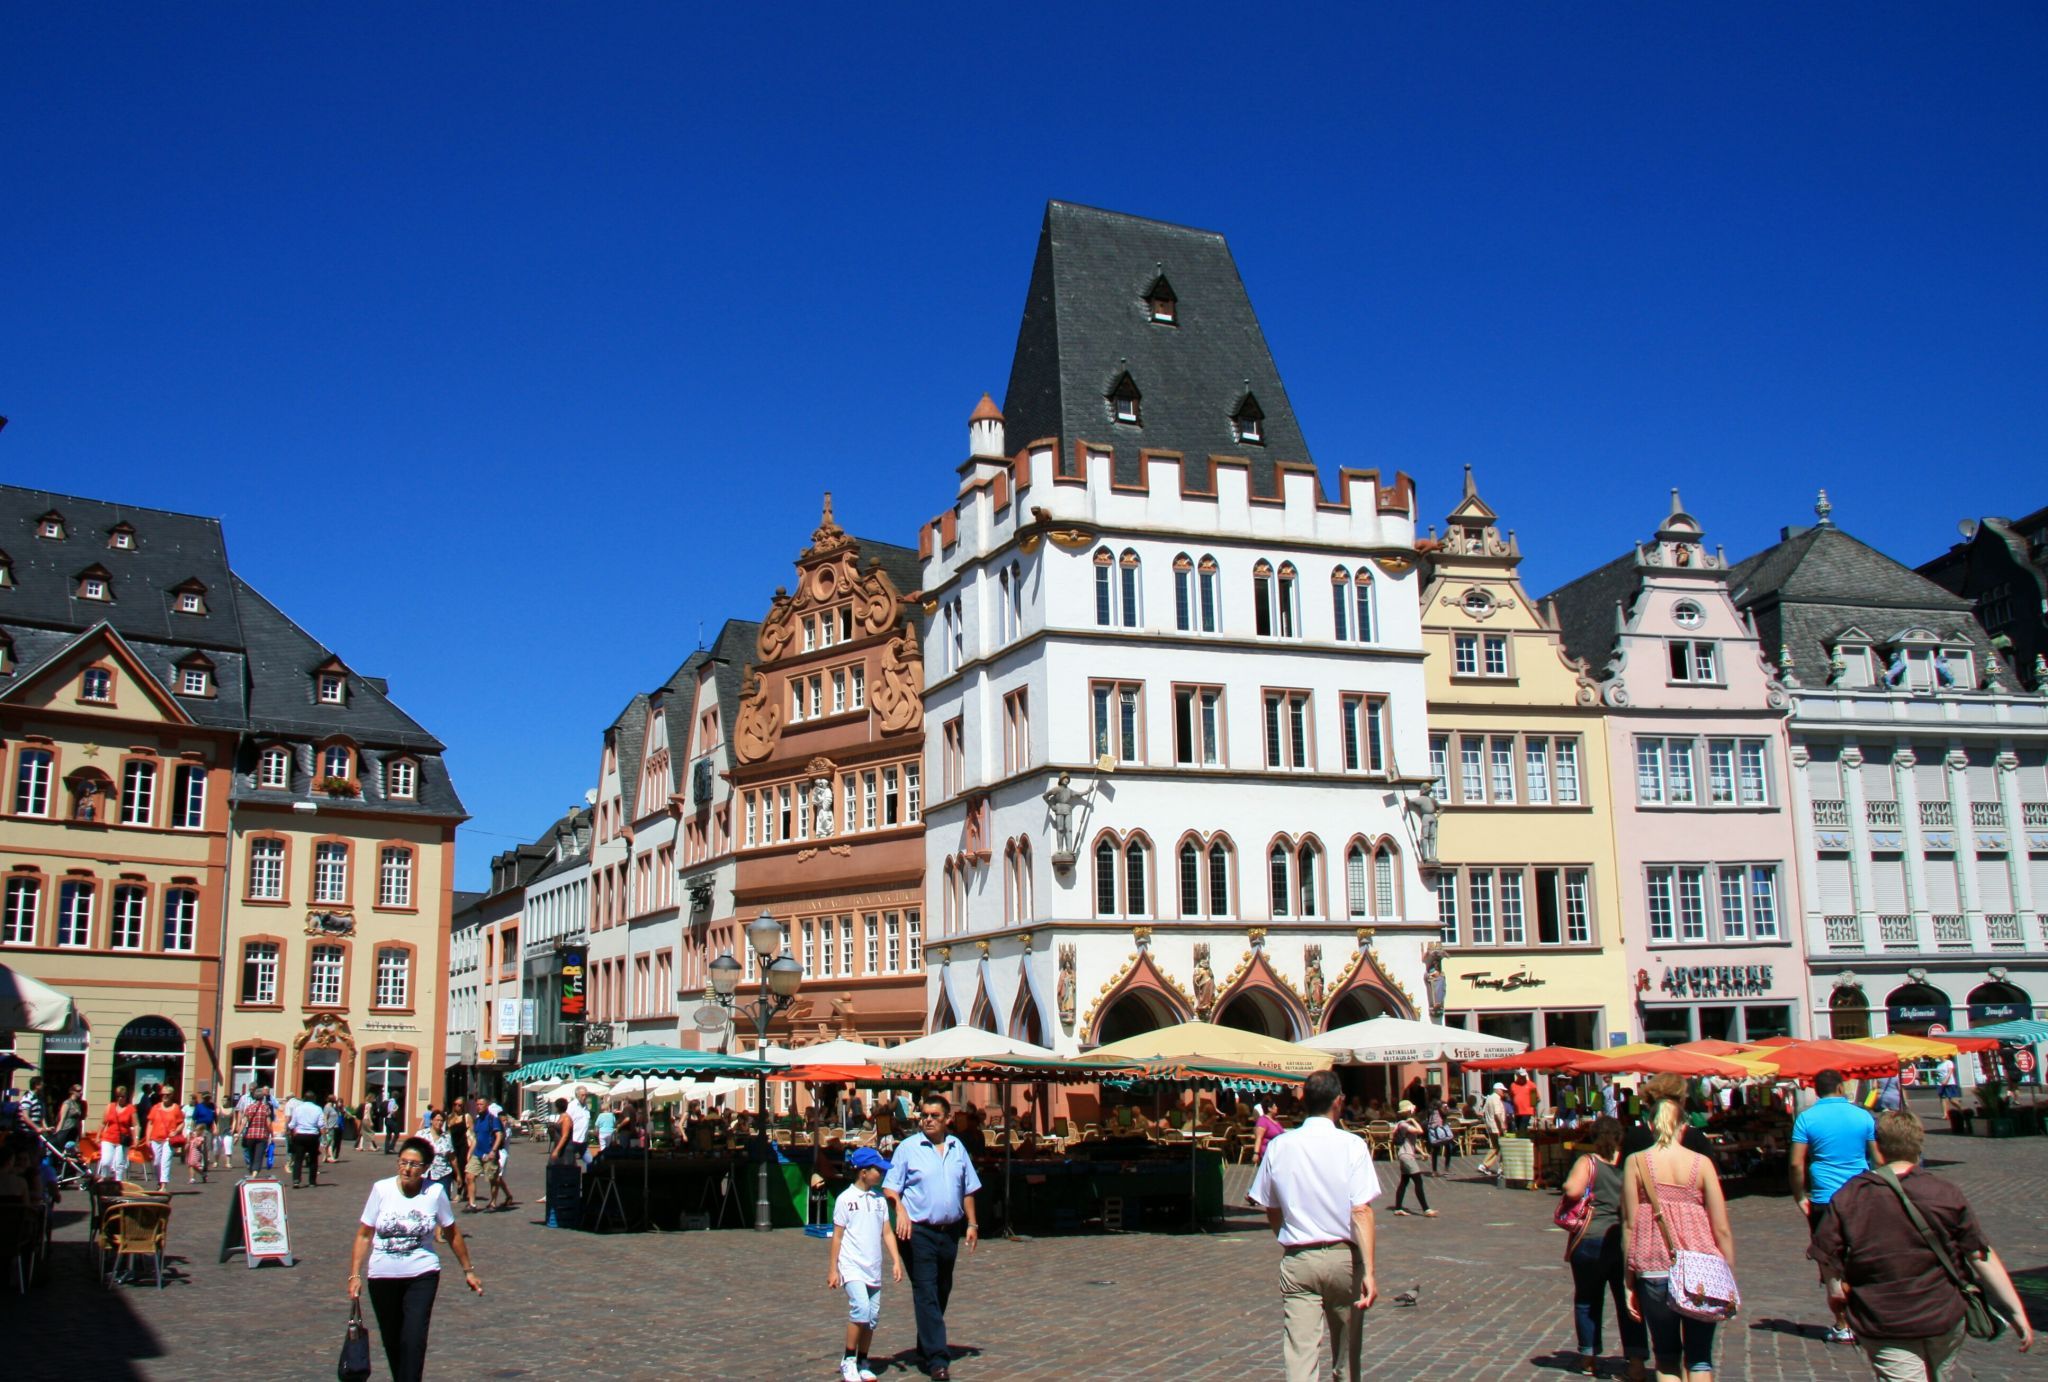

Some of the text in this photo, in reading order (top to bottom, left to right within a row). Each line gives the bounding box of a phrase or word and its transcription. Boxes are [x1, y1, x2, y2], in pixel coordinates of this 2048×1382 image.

[1662, 965, 1774, 982] APOTHEKE
[1984, 1005, 2013, 1017] Douglas
[848, 1202, 859, 1211] 21
